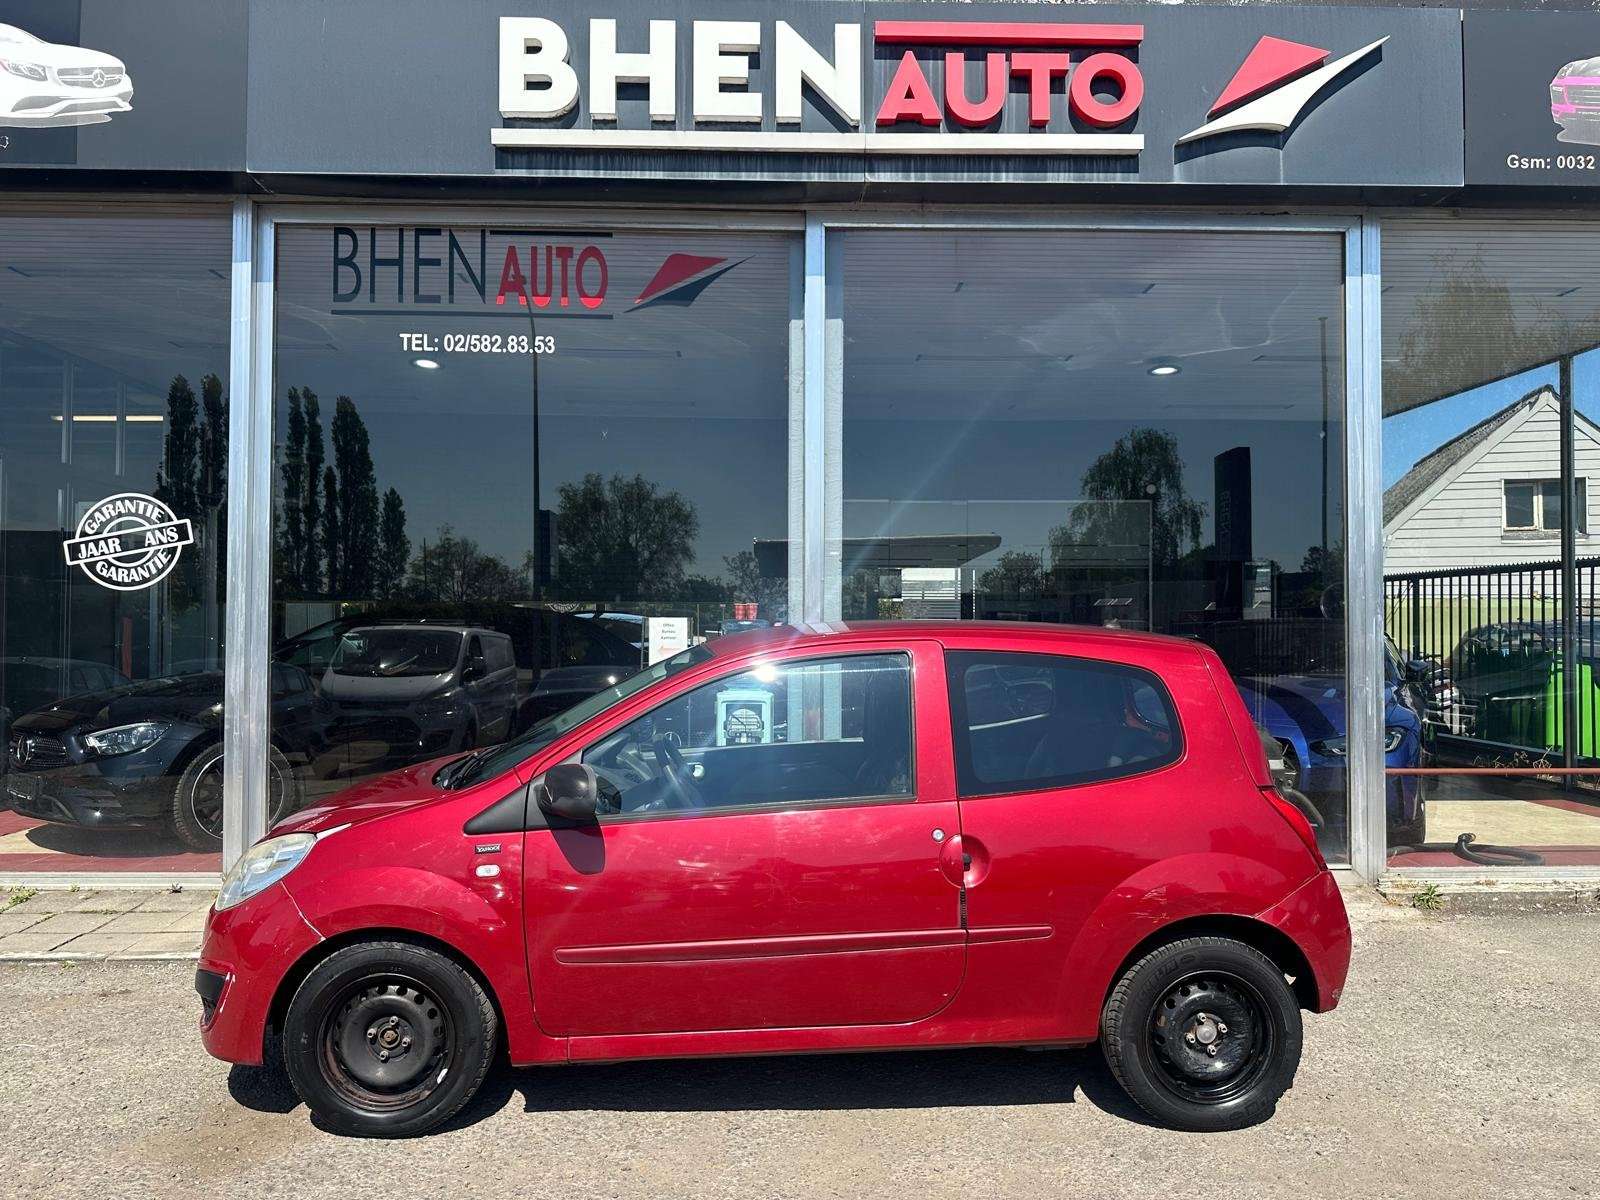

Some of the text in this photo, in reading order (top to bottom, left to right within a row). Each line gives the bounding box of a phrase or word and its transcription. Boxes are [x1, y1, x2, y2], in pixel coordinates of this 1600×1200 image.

[499, 16, 1144, 127] BHEN AUTO
[1506, 154, 1595, 170] Gsm: 0032
[332, 226, 608, 309] BHEN AUTO
[399, 333, 556, 354] TEL: 02/582.83.53
[84, 499, 165, 534] GARANTIE
[78, 526, 179, 560] JAAR ANS
[95, 549, 171, 582] GARANTIE
